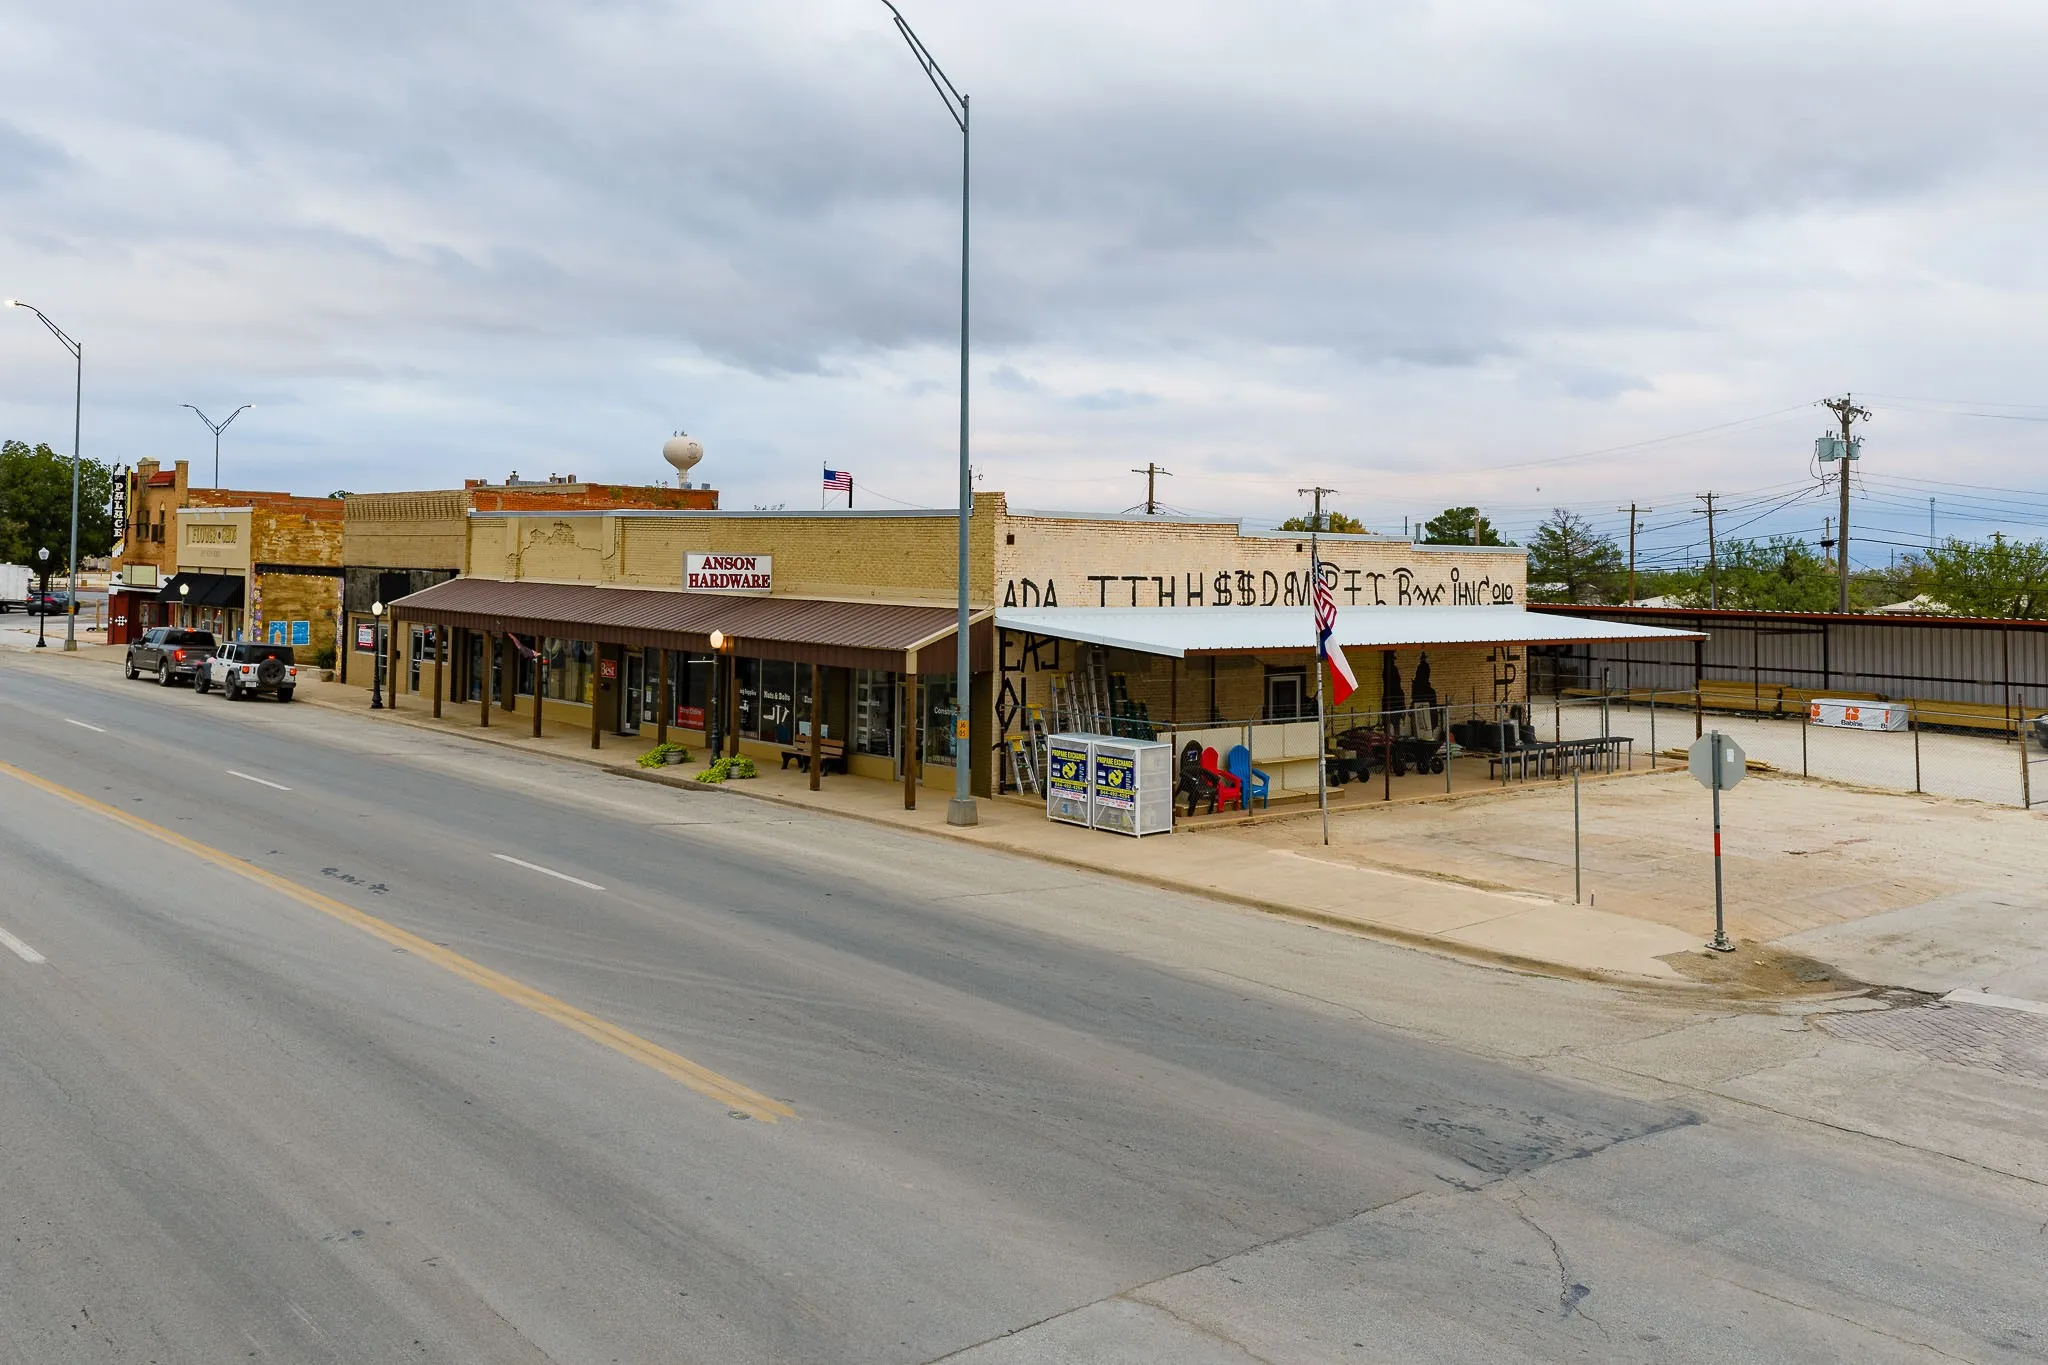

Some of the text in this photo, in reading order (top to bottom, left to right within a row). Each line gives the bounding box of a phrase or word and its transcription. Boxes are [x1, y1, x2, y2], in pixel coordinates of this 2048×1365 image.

[113, 483, 124, 538] PALACE
[701, 556, 757, 571] ANSON
[688, 573, 770, 588] HARDWARE
[763, 690, 774, 700] Nuts
[779, 692, 791, 701] Bolts
[1841, 719, 1863, 728] Babine
[1052, 749, 1068, 758] PROPANE
[1068, 750, 1087, 761] EXCHANGE
[1097, 756, 1113, 766] PROPANE
[1114, 757, 1133, 768] EXCHANGE
